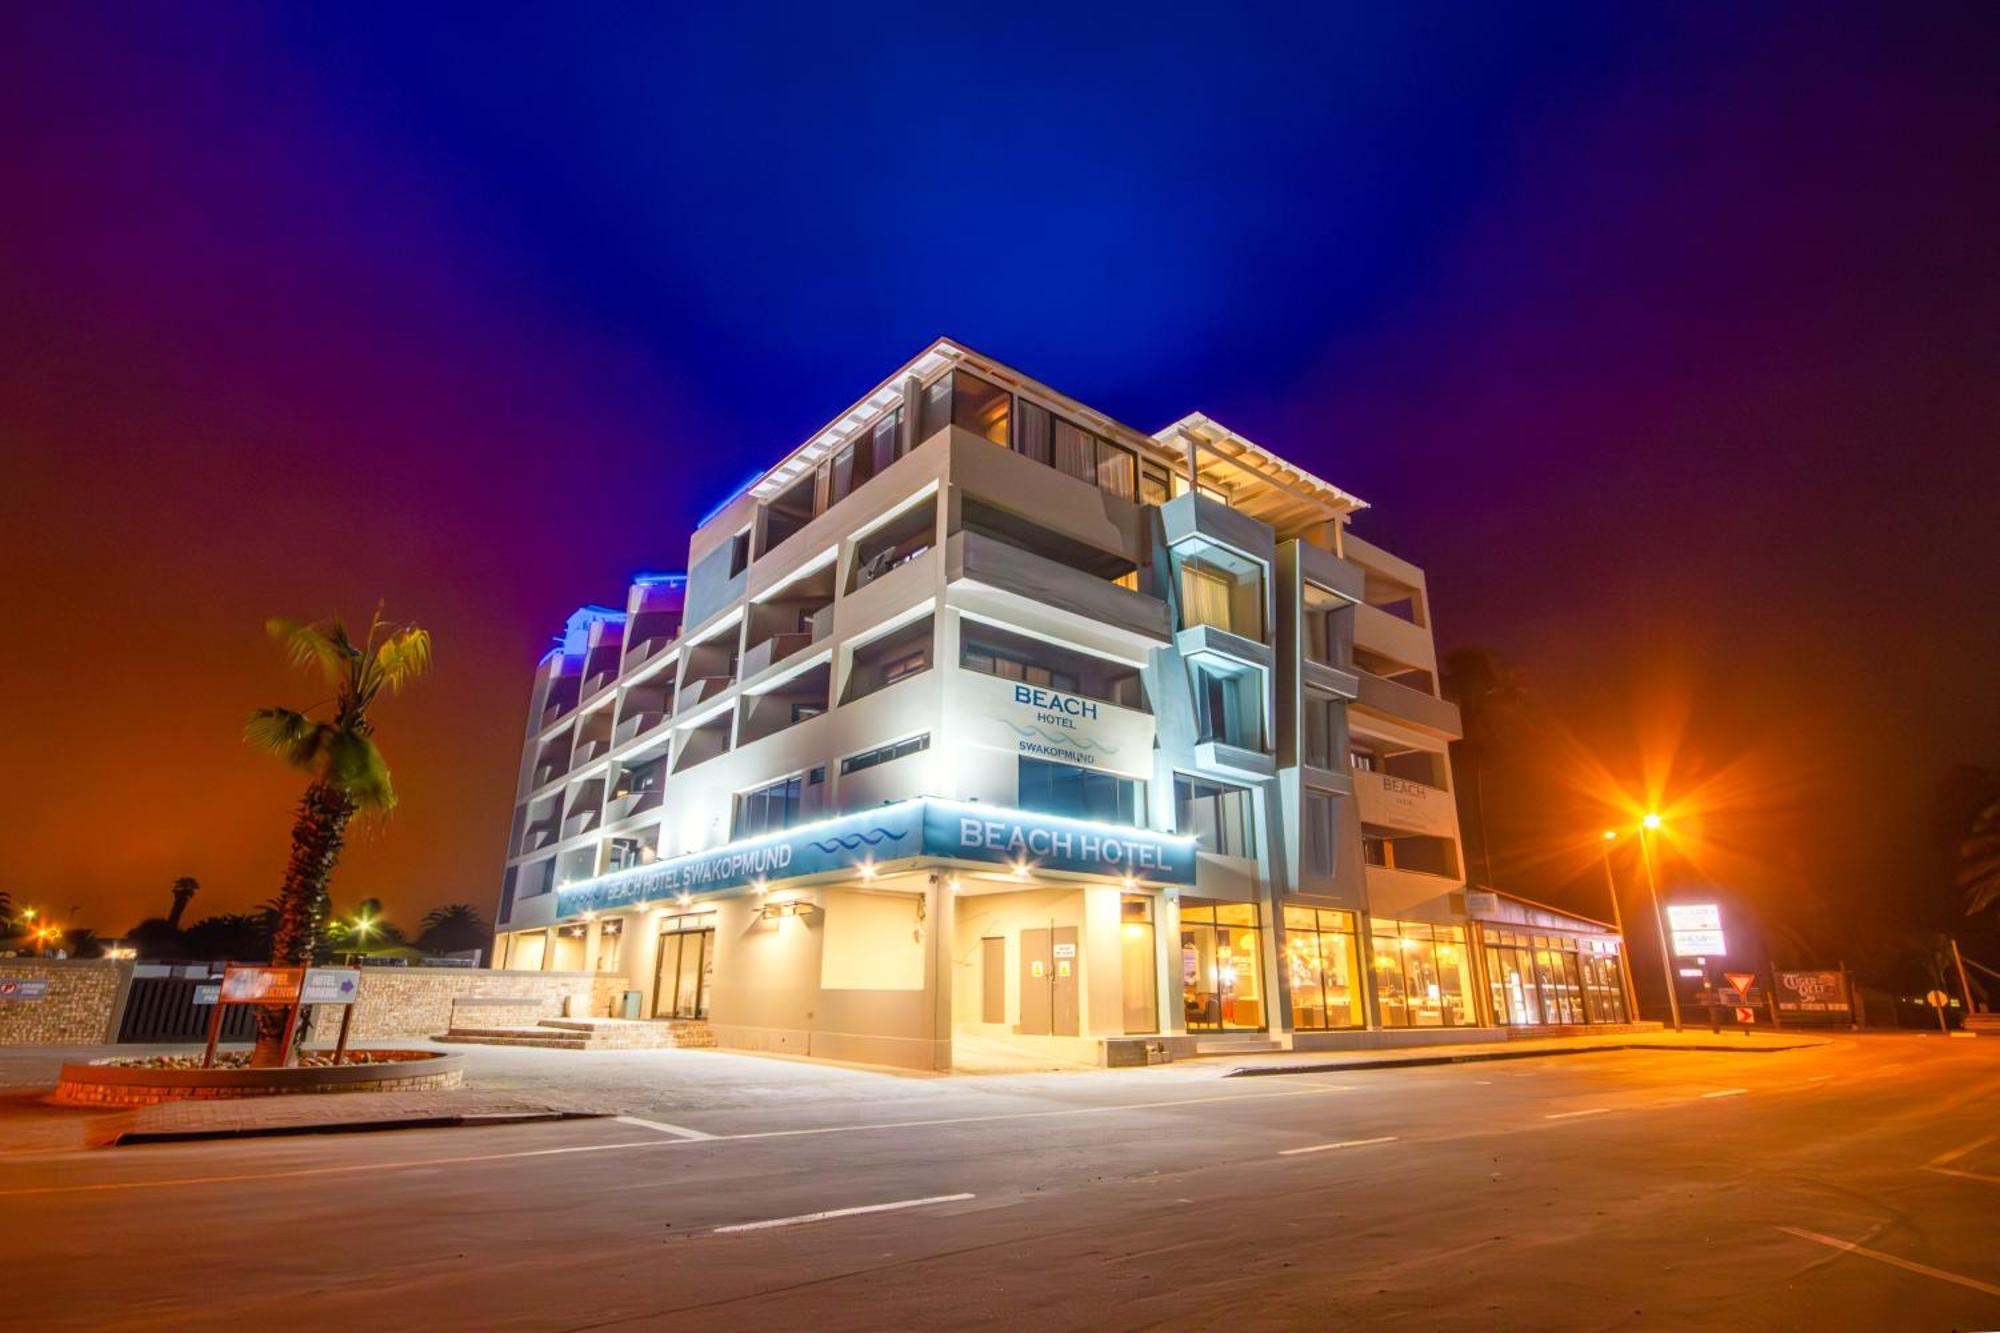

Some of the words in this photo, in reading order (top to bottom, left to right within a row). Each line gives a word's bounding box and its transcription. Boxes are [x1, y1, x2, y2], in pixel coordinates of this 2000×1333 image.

[1015, 684, 1097, 720] BEACH
[1037, 712, 1077, 730] HOTEL
[1018, 740, 1095, 764] SWAKOPMUND
[1383, 778, 1426, 800] BEACH
[959, 818, 1073, 860] BEACH
[1080, 832, 1173, 872] HOTEL
[606, 876, 642, 900] BEACH
[642, 870, 681, 893] HOTEL
[683, 844, 792, 885] SWAKOPMUND
